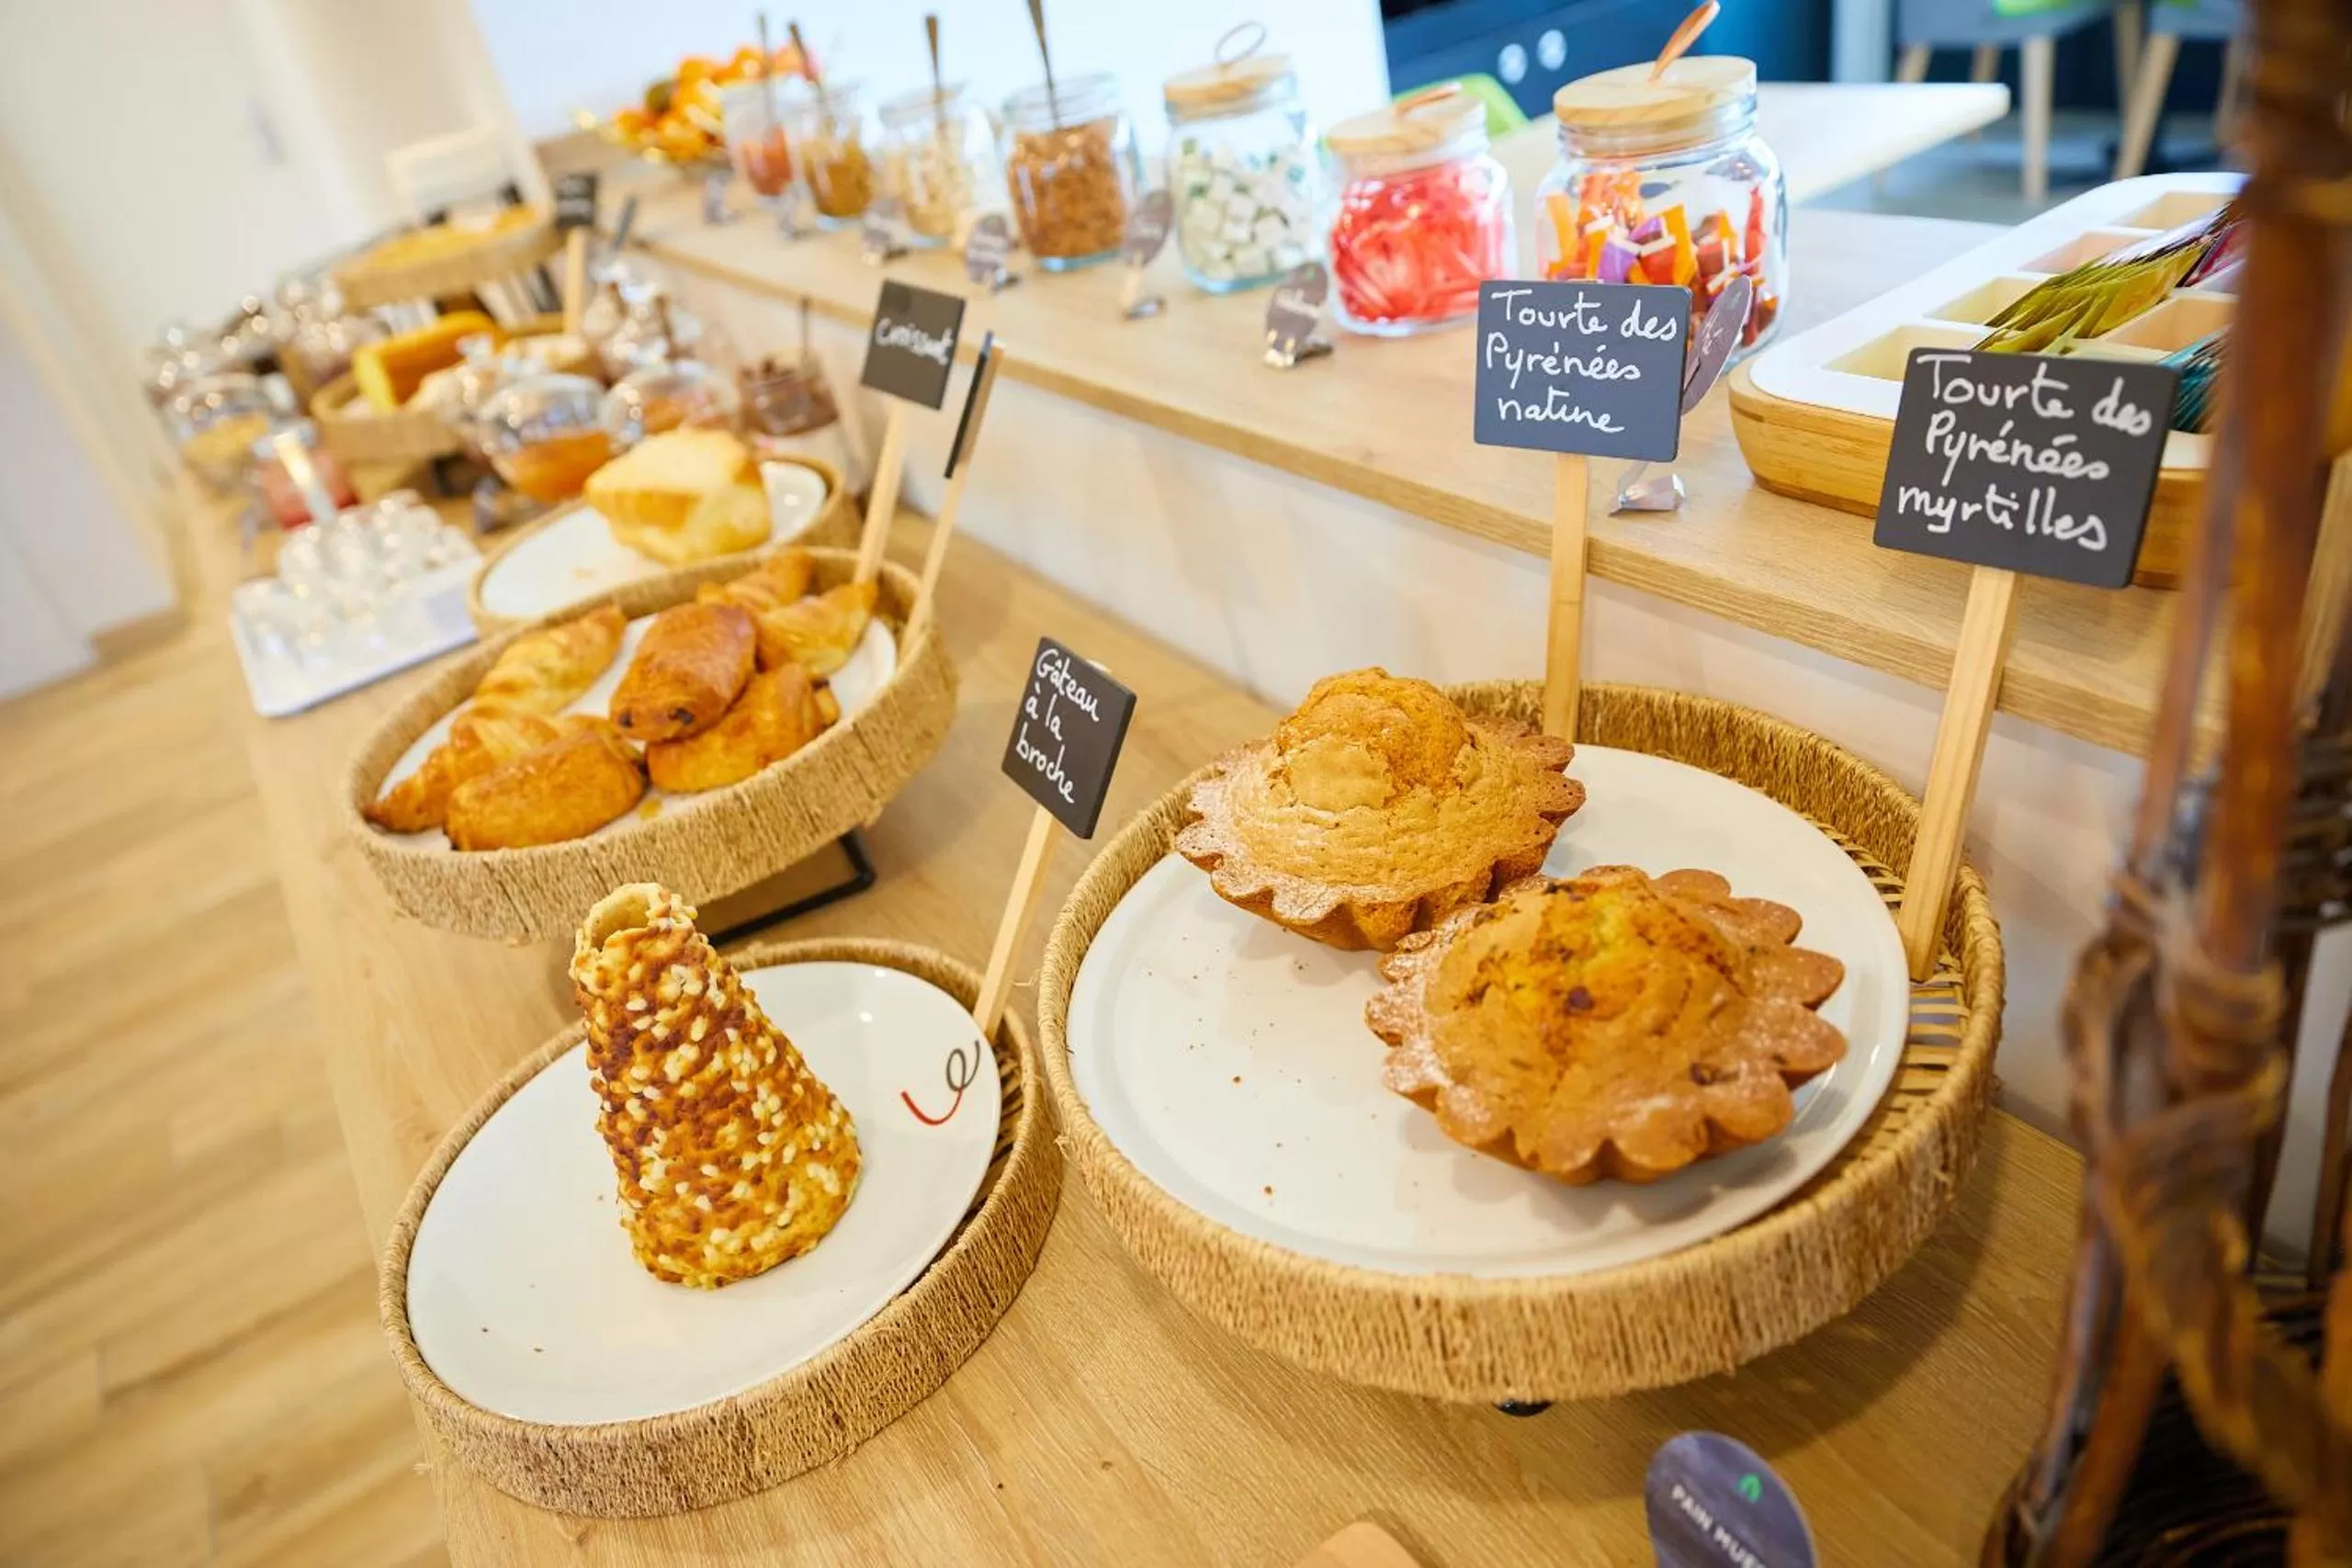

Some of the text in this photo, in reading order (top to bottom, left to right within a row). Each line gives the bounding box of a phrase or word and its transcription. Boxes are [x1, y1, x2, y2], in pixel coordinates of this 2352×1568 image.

[1490, 288, 1608, 334] Tourte
[1620, 299, 1678, 342] des
[1485, 331, 1642, 389] Pyrénées
[1497, 386, 1625, 434] nature
[1916, 353, 2153, 436] Tourte des
[1925, 410, 2110, 487] Pyrénées
[1897, 483, 2108, 551] myrtilles
[1024, 681, 1063, 741] à la
[1035, 648, 1101, 722] Gâteau
[1015, 721, 1076, 804] broche
[1670, 1483, 1713, 1532] PAIN
